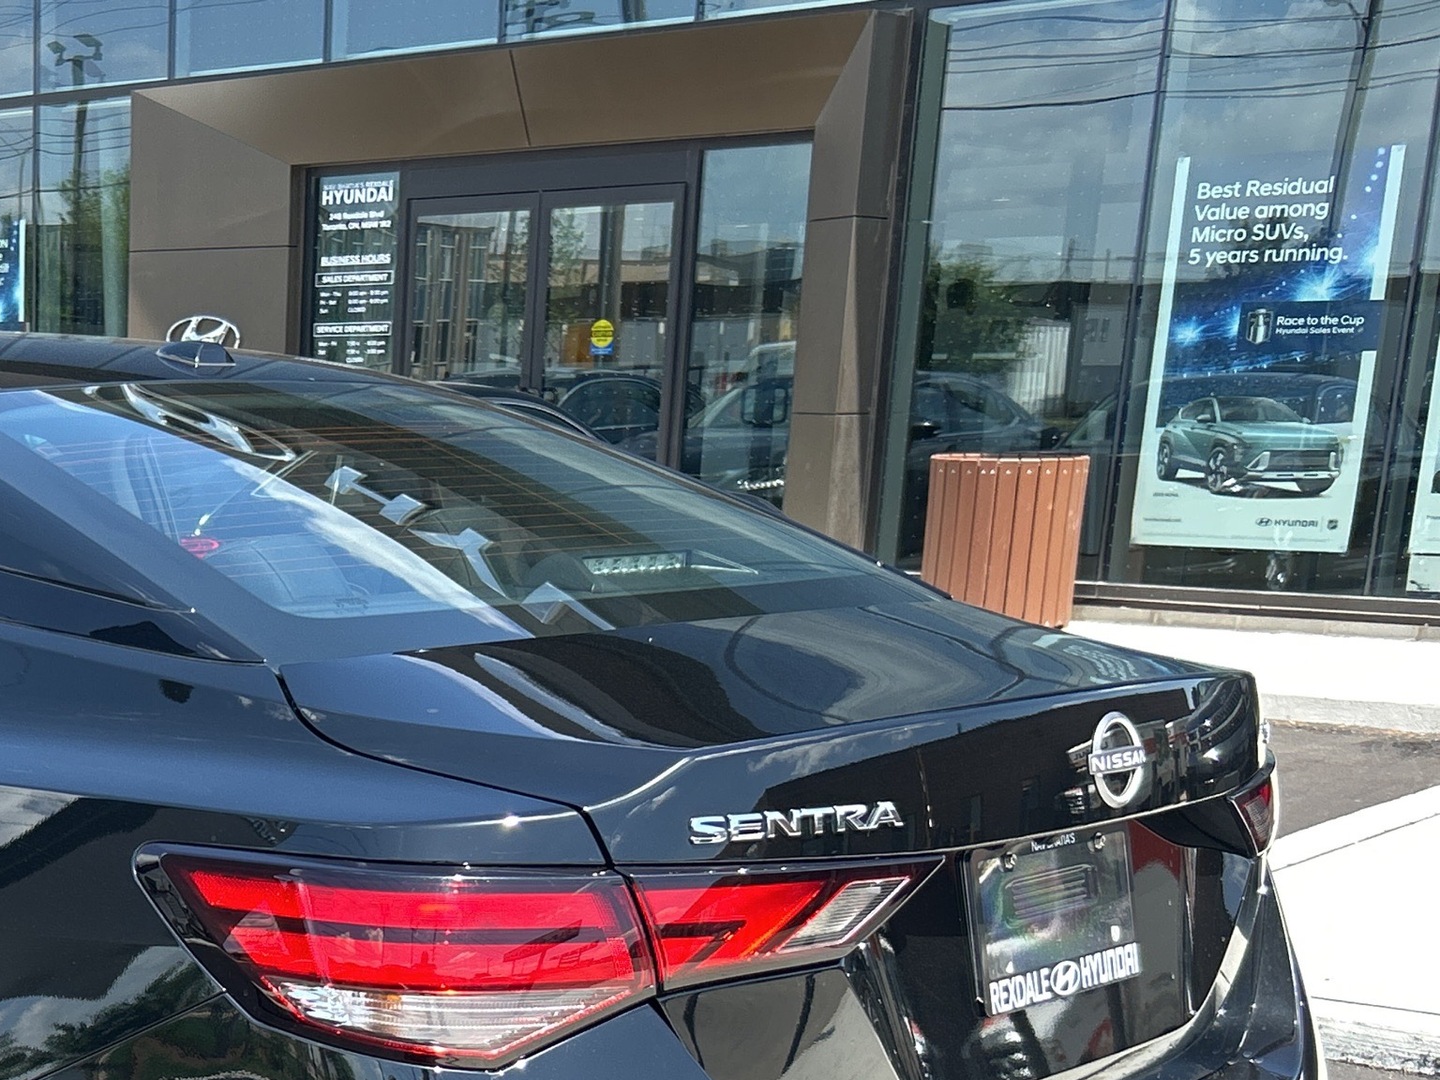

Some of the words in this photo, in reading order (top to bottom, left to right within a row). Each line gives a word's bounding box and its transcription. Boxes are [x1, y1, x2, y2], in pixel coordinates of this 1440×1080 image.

[322, 186, 394, 206] HYUNDAI
[1196, 181, 1242, 200] Best
[1246, 176, 1335, 197] Residual
[1194, 203, 1250, 221] Value
[1254, 202, 1329, 220] among
[1191, 225, 1247, 243] Micro
[1251, 222, 1309, 242] SUVs,
[361, 253, 391, 265] HOURS
[1188, 248, 1201, 265] 5
[1205, 249, 1259, 267] years
[1264, 244, 1348, 265] running.
[343, 273, 388, 283] DEPARTMENT
[1275, 327, 1308, 335] Hyundai
[1332, 326, 1355, 334] Event
[1276, 316, 1305, 326] Race
[1306, 316, 1319, 326] to
[1320, 315, 1338, 325] the
[1340, 315, 1365, 327] Cup
[1273, 518, 1319, 528] HYUNDAI
[1090, 746, 1147, 772] NISSAN
[688, 801, 904, 846] SENTRA
[989, 967, 1053, 1015] REXDALE
[1079, 942, 1140, 989] HYUNDAI
